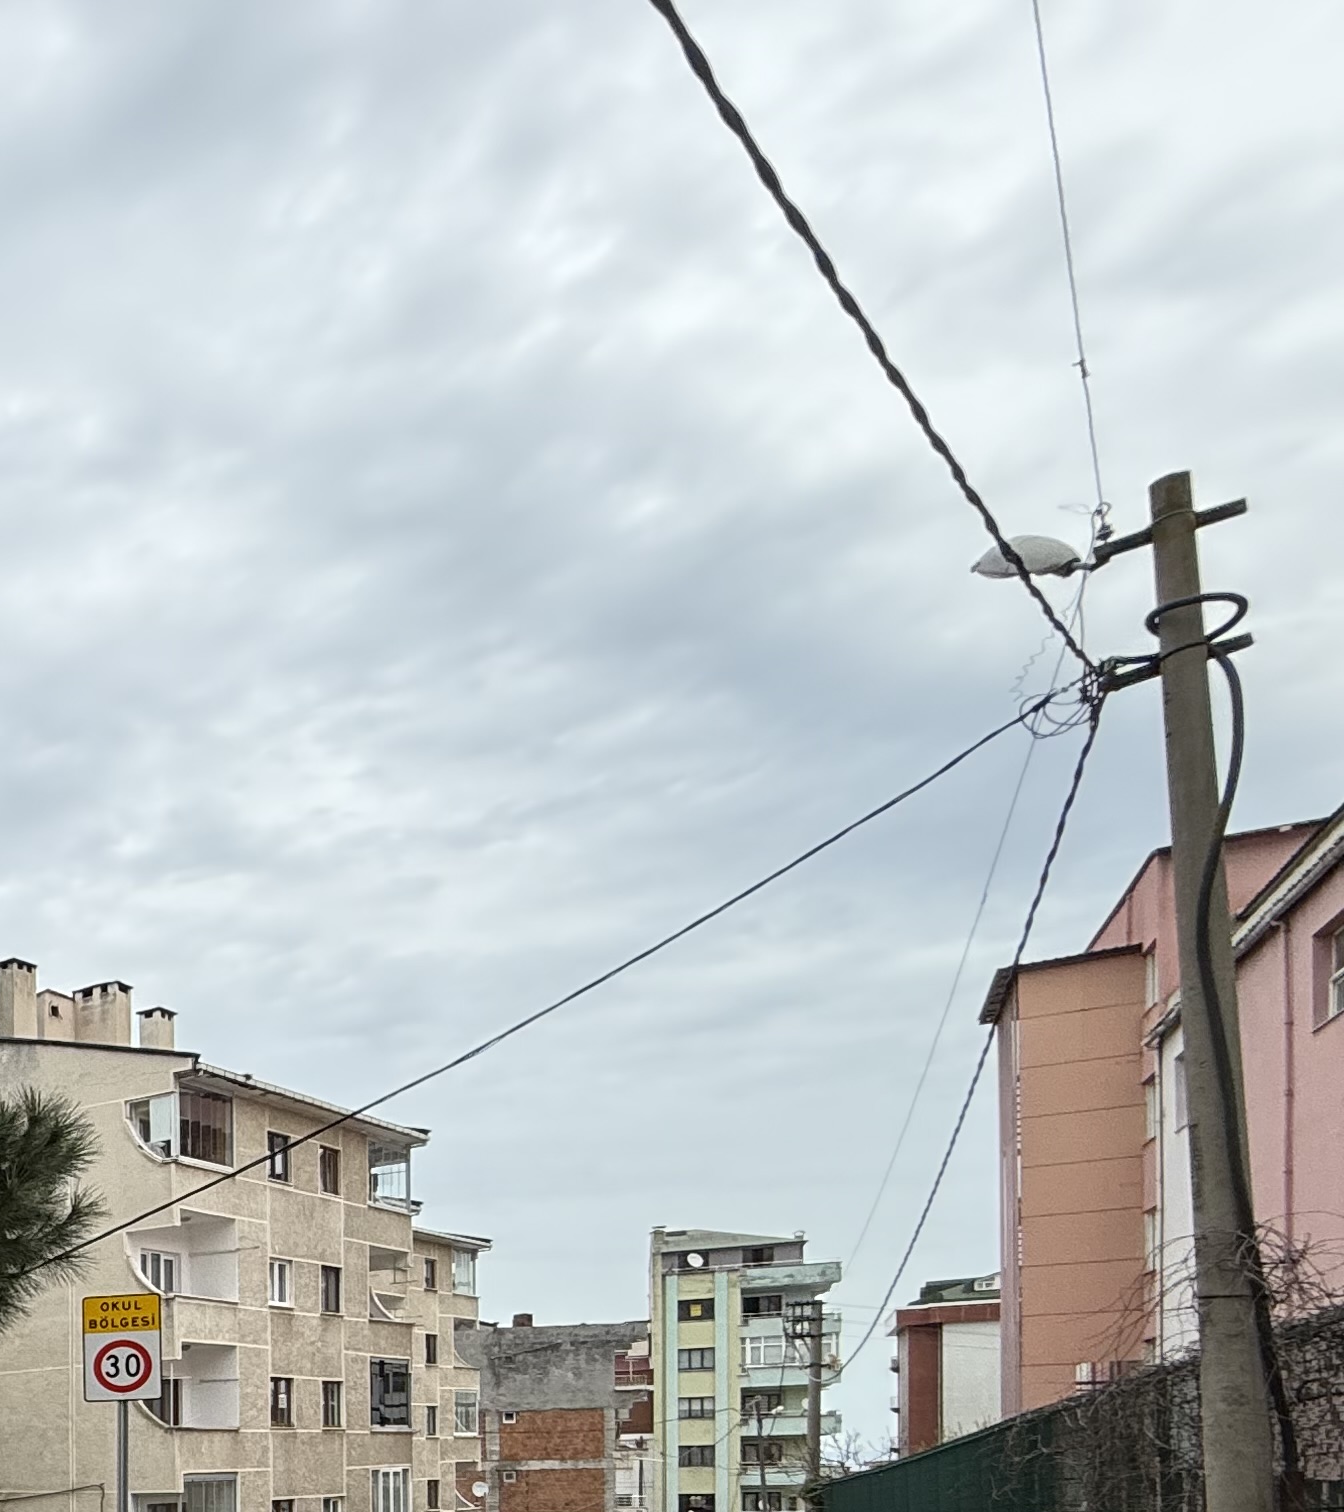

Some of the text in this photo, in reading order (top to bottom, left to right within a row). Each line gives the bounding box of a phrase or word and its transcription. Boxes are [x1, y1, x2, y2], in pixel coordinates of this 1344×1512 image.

[100, 1300, 143, 1312] OKUL
[88, 1313, 156, 1329] BÖLGESİ
[105, 1353, 141, 1378] 30
